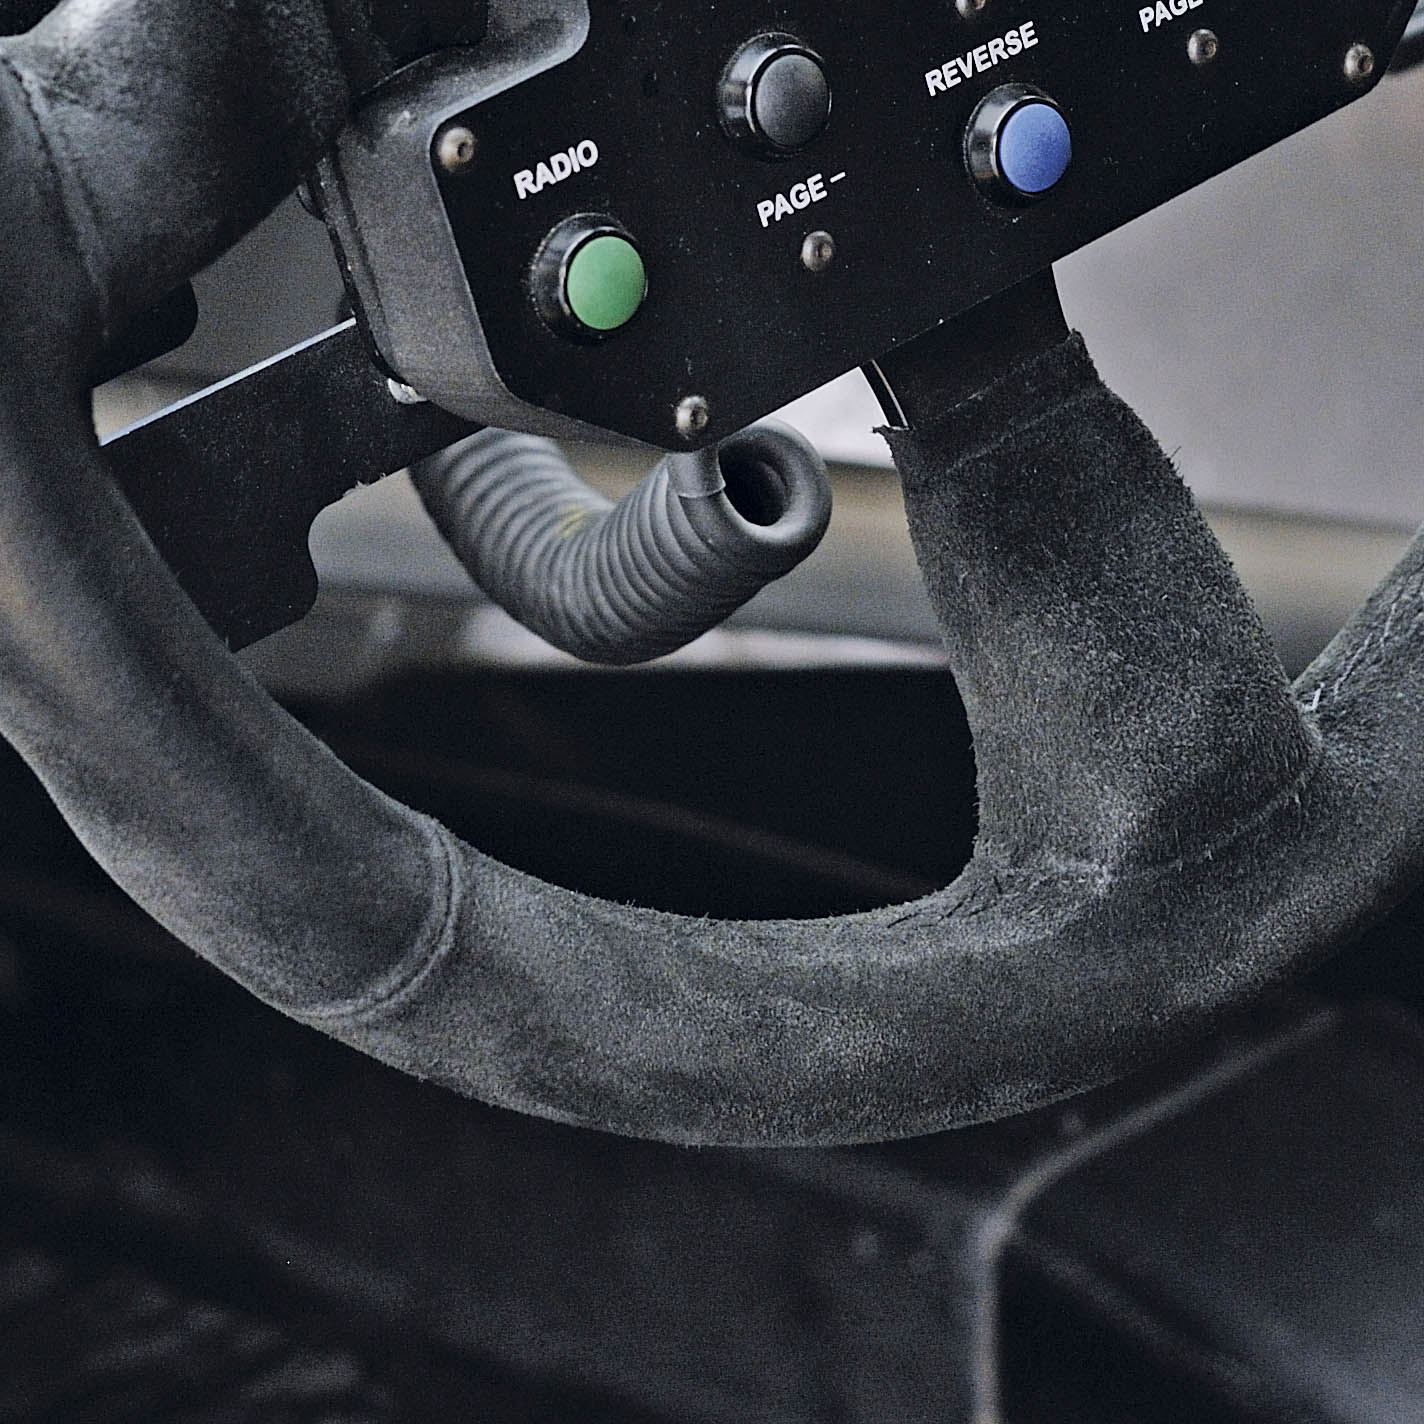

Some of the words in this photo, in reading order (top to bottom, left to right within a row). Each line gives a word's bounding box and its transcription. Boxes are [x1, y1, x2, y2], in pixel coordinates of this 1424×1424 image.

[924, 20, 1040, 97] REVERSE
[513, 139, 600, 200] RADIO
[756, 173, 829, 228] PAGE
